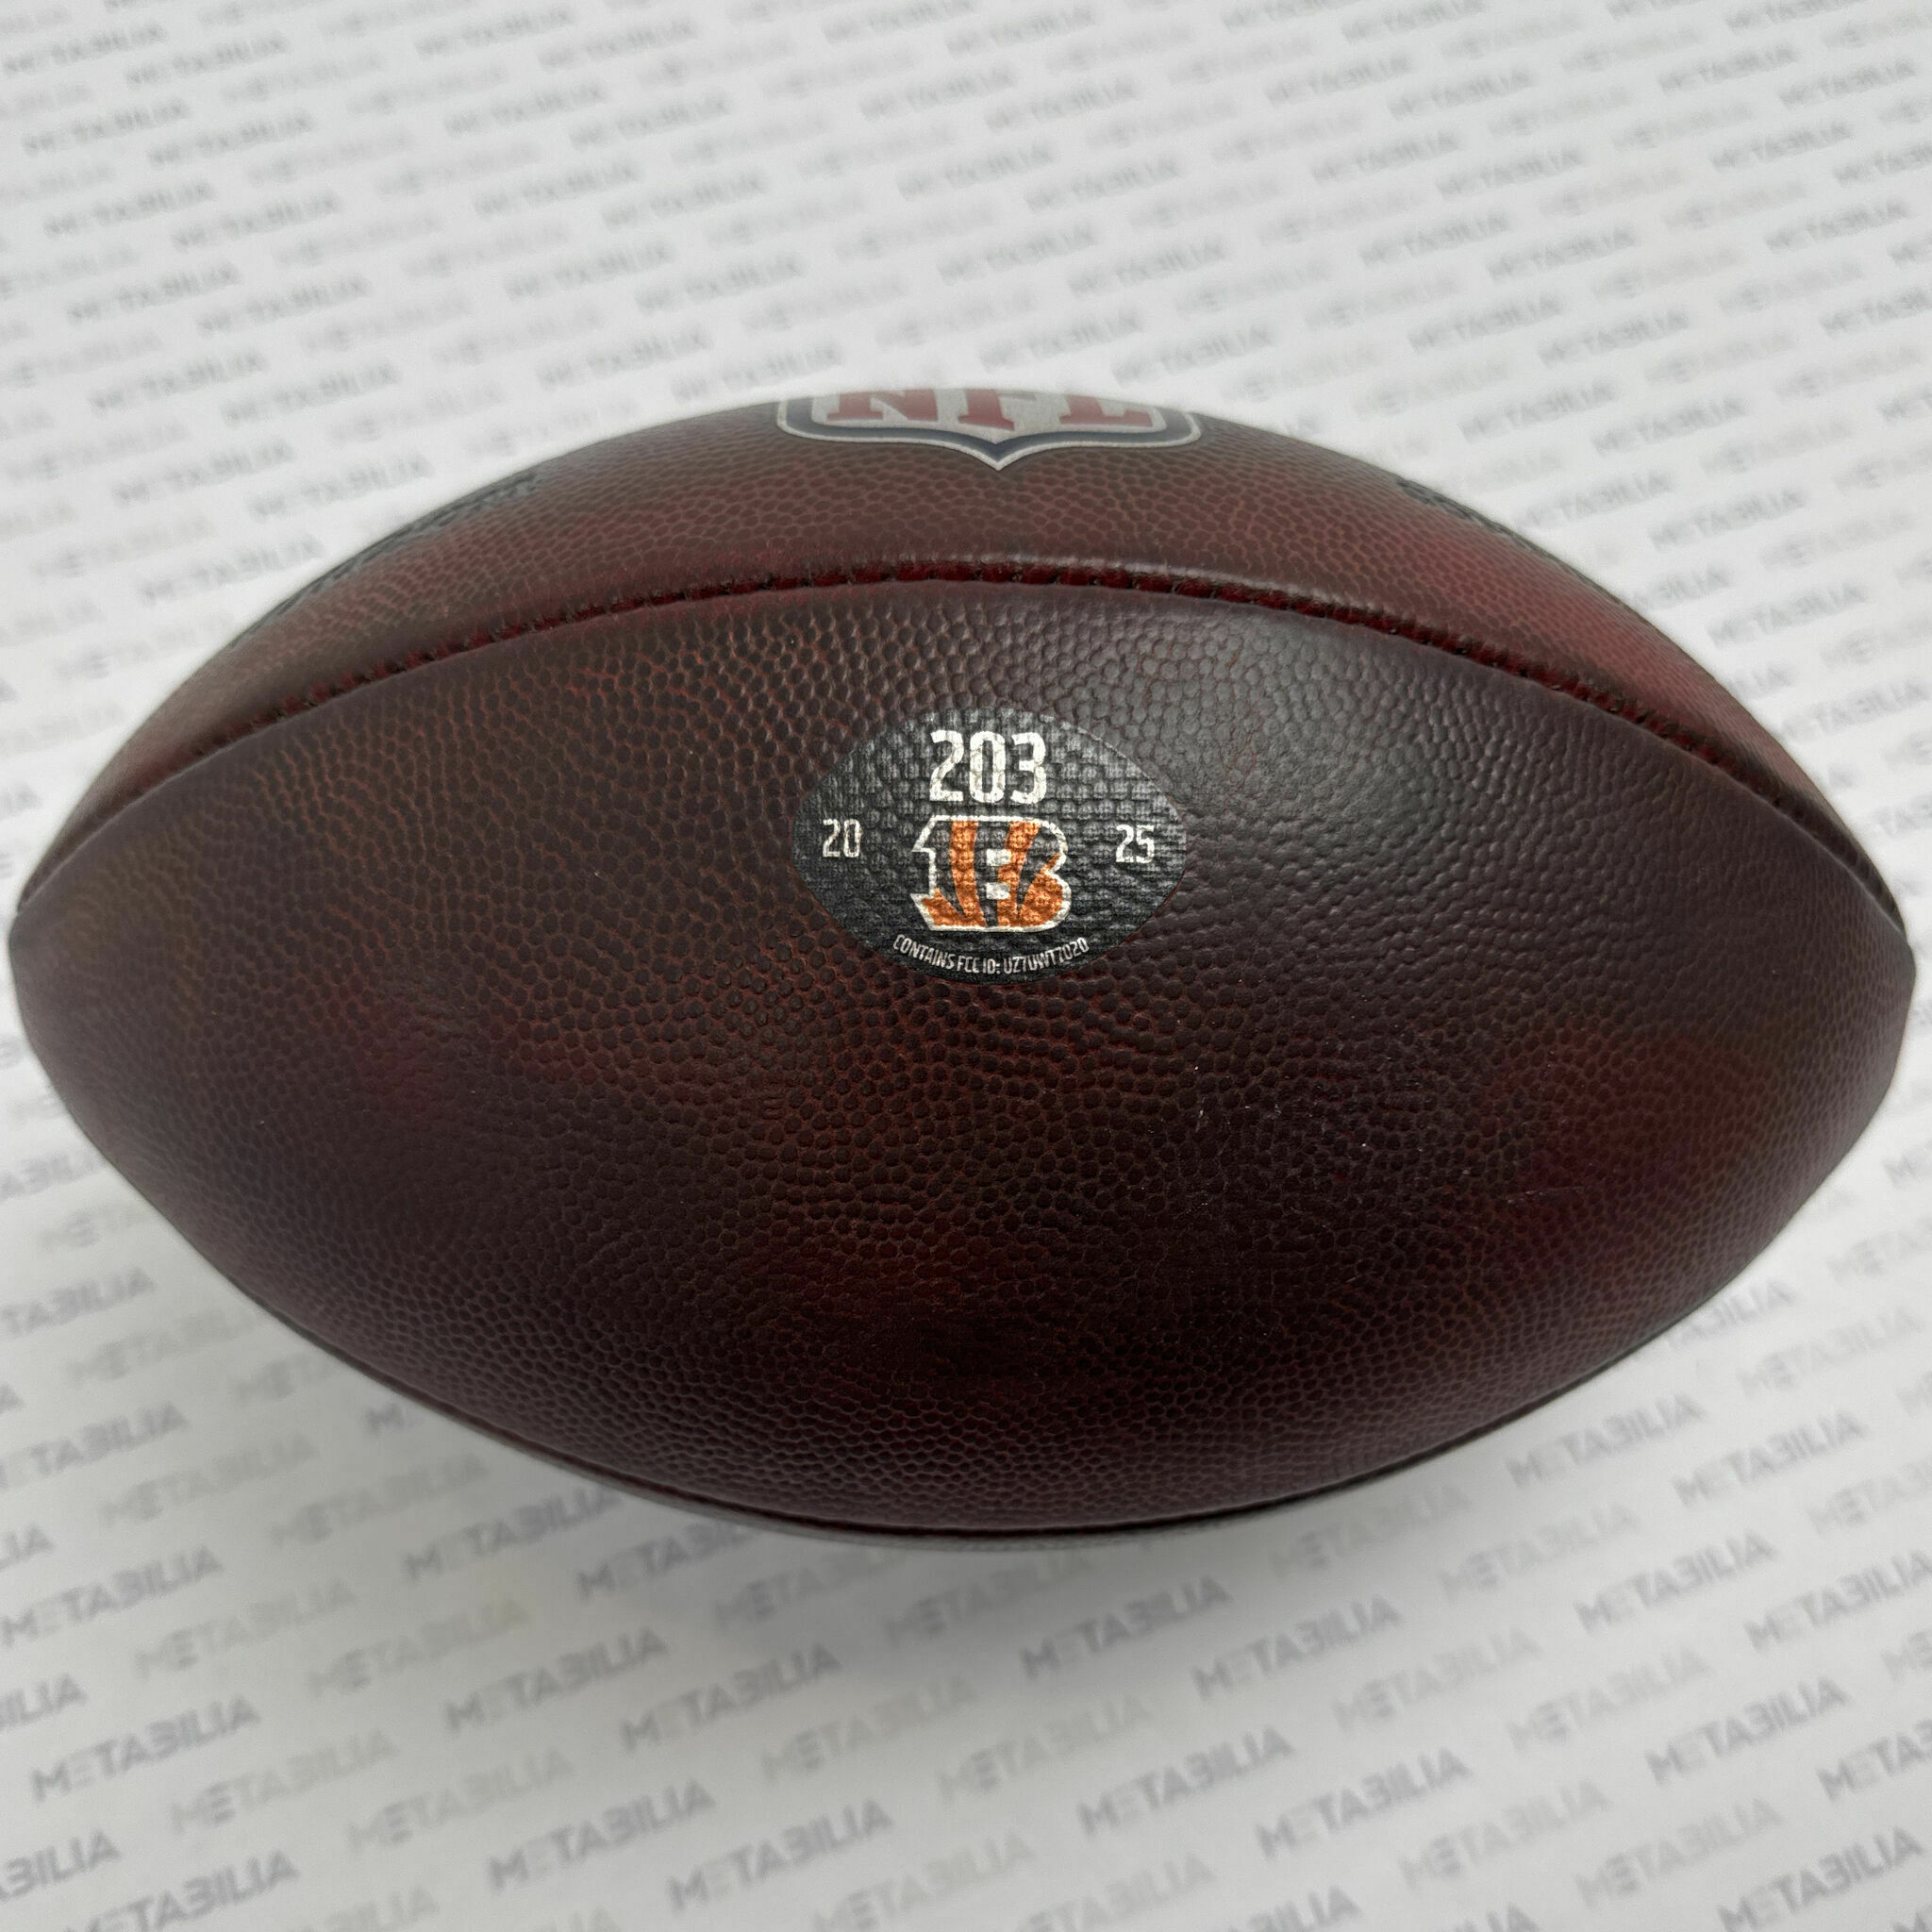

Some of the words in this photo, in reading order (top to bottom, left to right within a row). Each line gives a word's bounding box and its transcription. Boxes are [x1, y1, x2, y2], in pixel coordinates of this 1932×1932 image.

[929, 729, 1047, 804] 203
[822, 818, 862, 858] 20
[1115, 824, 1156, 865] 25
[892, 934, 955, 970] CONTAINS
[957, 955, 980, 974] FCC
[982, 958, 1001, 974] ID:
